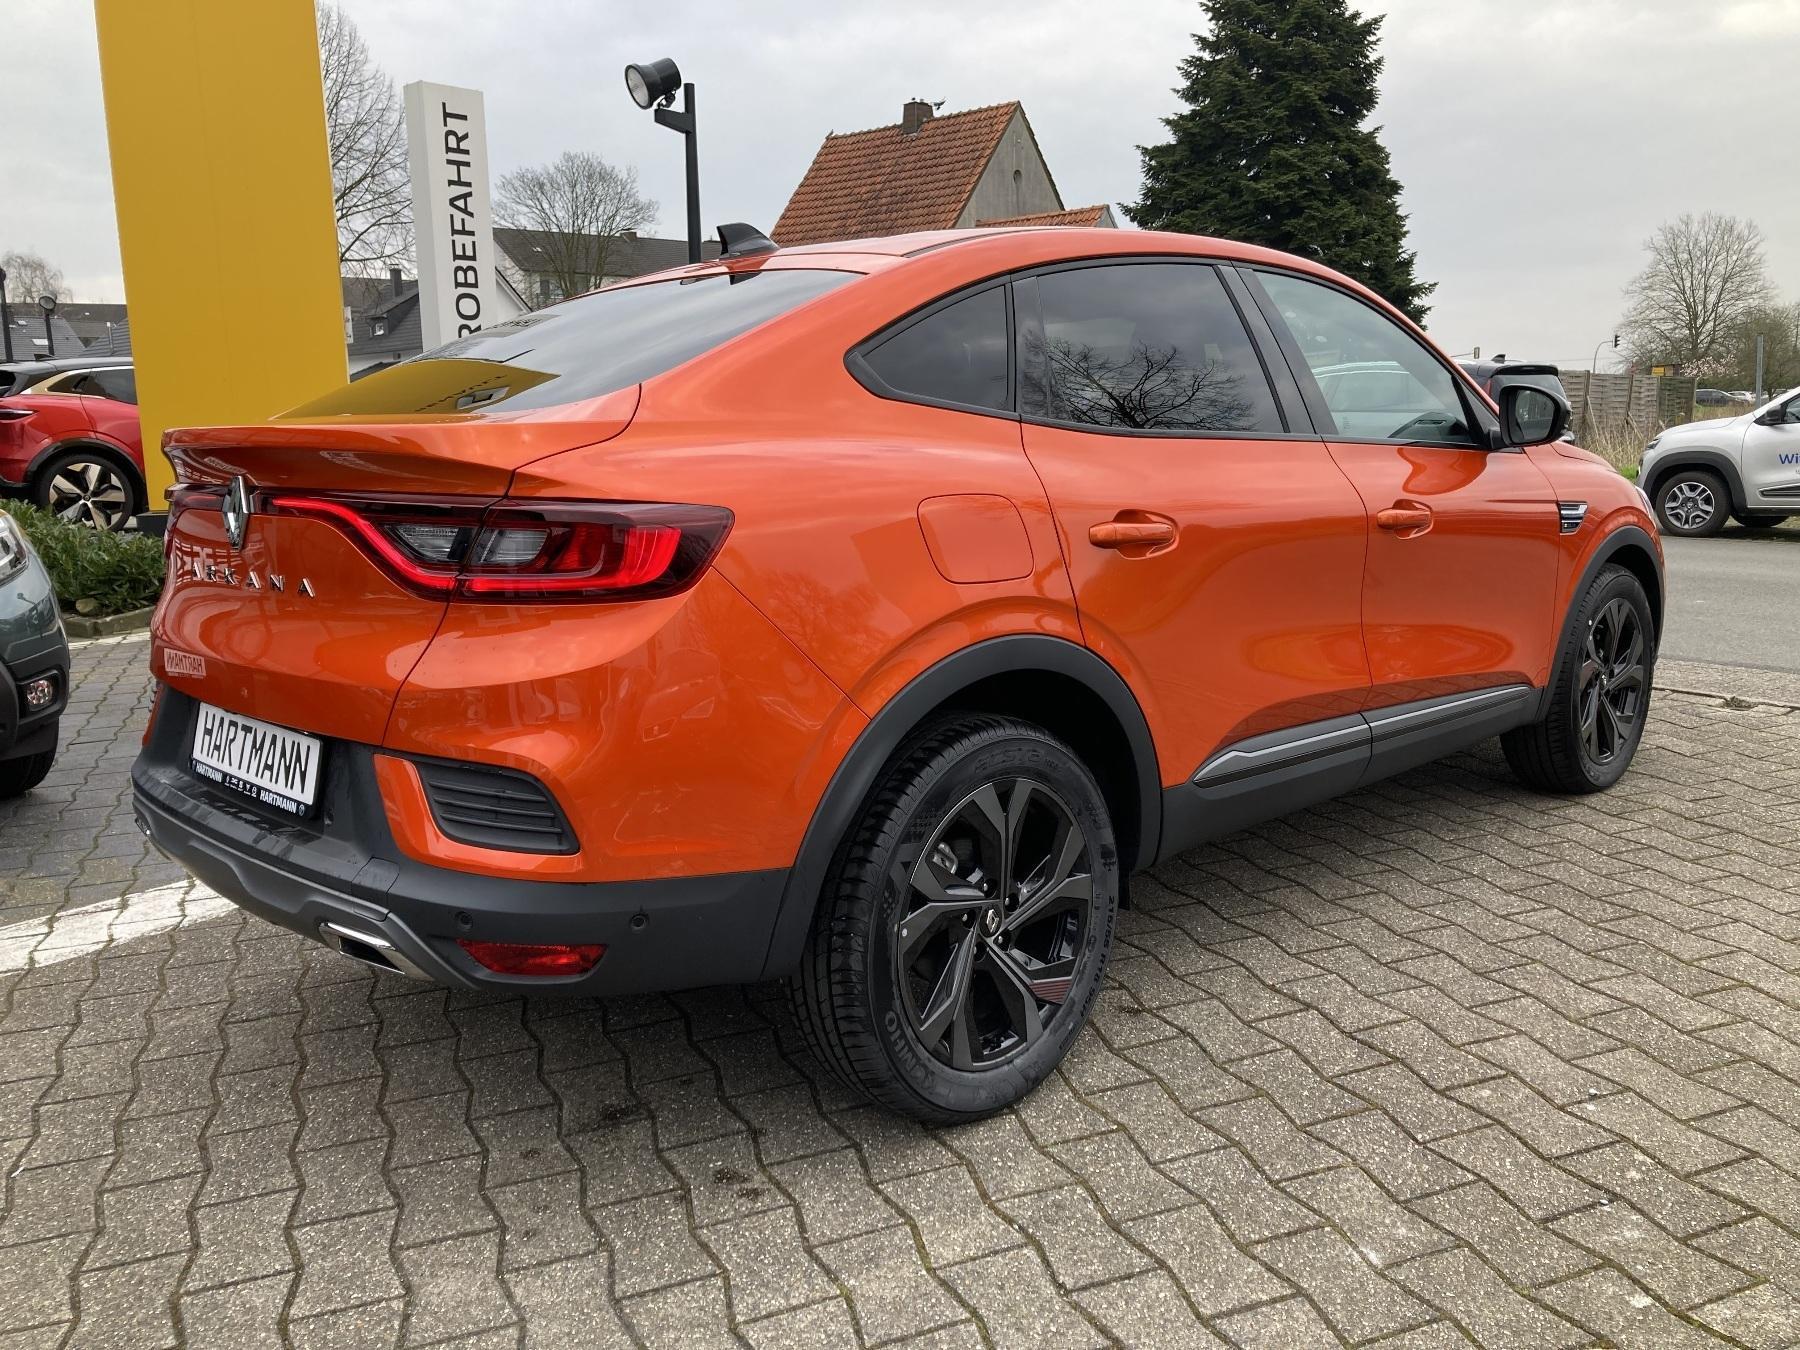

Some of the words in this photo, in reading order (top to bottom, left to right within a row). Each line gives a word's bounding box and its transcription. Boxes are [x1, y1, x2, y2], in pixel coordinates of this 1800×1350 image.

[1779, 453, 1800, 465] Wi
[192, 561, 315, 598] ARKANA
[201, 710, 311, 794] HARTMANN
[195, 762, 223, 783] HARTMANN
[260, 789, 297, 814] HARTMANN
